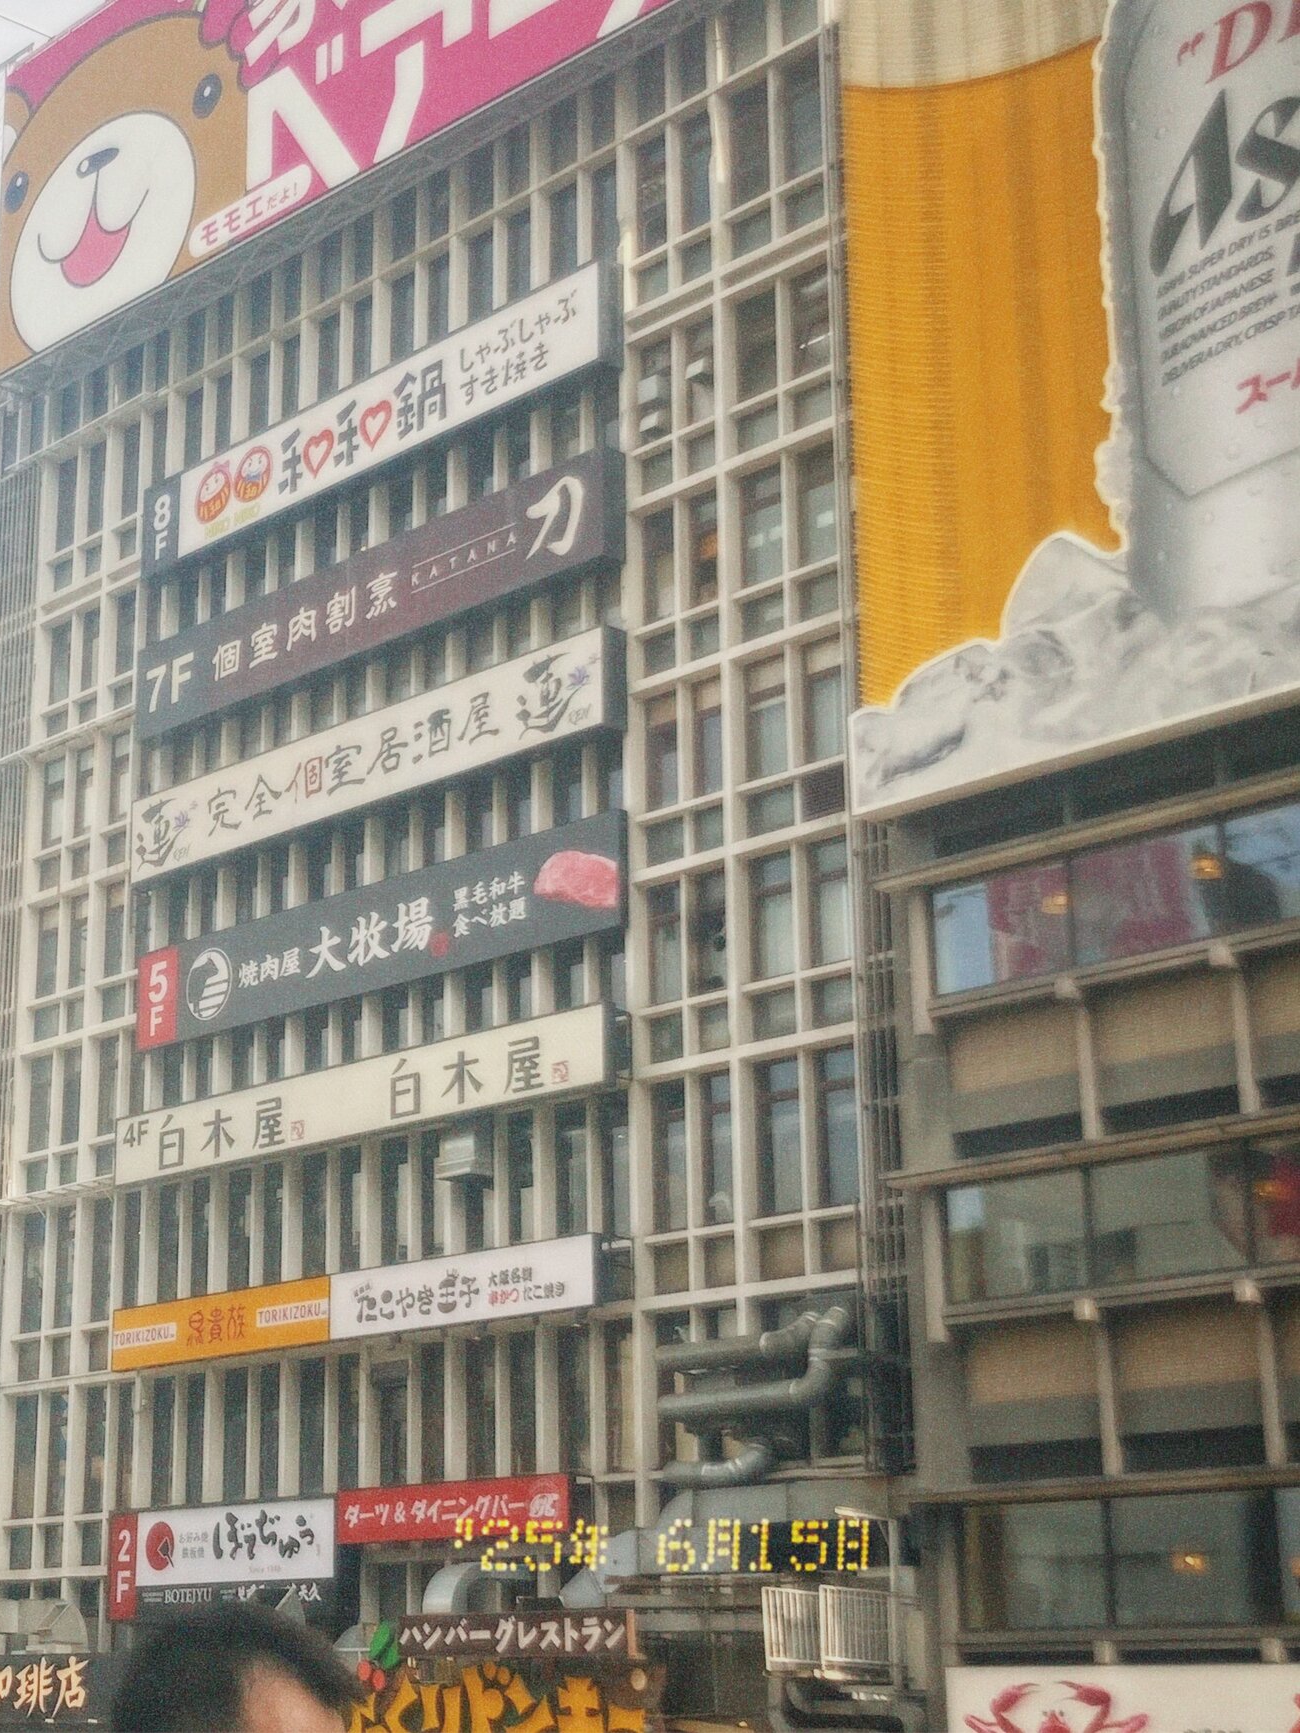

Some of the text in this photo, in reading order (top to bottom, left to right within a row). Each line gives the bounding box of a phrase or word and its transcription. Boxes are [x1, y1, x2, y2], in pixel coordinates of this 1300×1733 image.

[459, 288, 578, 373] しゃぶしゃぶ
[459, 341, 549, 406] すき焼き
[153, 493, 172, 562] 8F
[526, 475, 584, 561] 刀
[411, 530, 517, 587] KATANA
[211, 570, 399, 682] 個室肉割烹
[146, 650, 195, 713] 7F
[207, 691, 502, 837] 完全個室居酒屋
[453, 871, 526, 912] 黒毛和牛
[453, 896, 527, 938] 食べ放題
[238, 946, 301, 988] 焼肉屋
[305, 896, 434, 979] 大牧場
[148, 960, 169, 1037] 5F
[122, 1035, 544, 1171] 4F 白木屋 白木屋
[116, 1528, 132, 1603] 2F
[164, 1586, 213, 1604] BOTEJYU
[399, 1615, 626, 1653] ハンバーグレストラン
